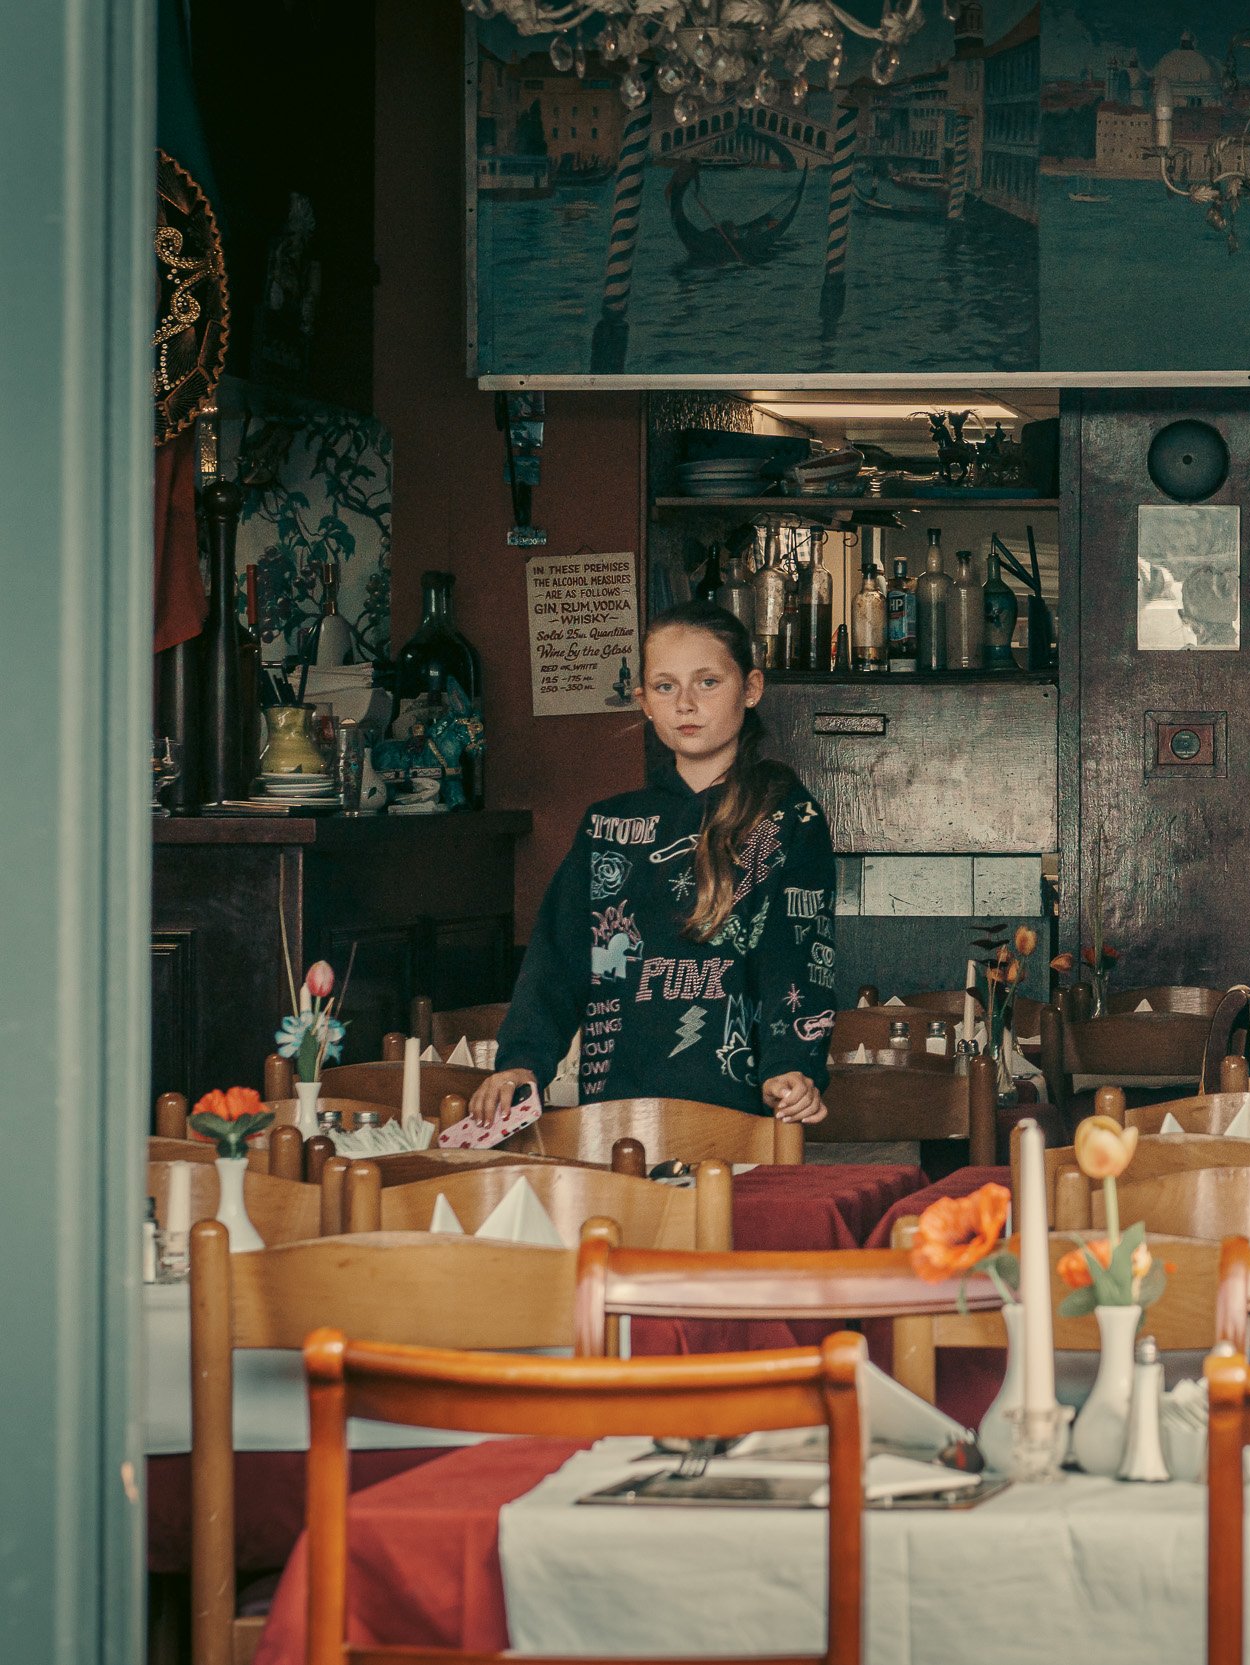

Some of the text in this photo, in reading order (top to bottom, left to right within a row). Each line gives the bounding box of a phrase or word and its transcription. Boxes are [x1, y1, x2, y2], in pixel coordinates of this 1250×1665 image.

[533, 562, 630, 575] IN THESE PREMISES
[533, 574, 631, 588] THE ALCOHOL MEASURES
[546, 587, 620, 600] ARE AS FOLLOWS
[534, 602, 558, 615] GIN,
[889, 599, 903, 611] HP
[560, 613, 610, 625] WHISKY
[536, 630, 564, 641] Sold
[536, 642, 632, 661] Wine by the Glass
[540, 664, 558, 672] RED
[542, 676, 559, 684] 125
[636, 957, 734, 1002] PUNK
[582, 1038, 615, 1056] OUR
